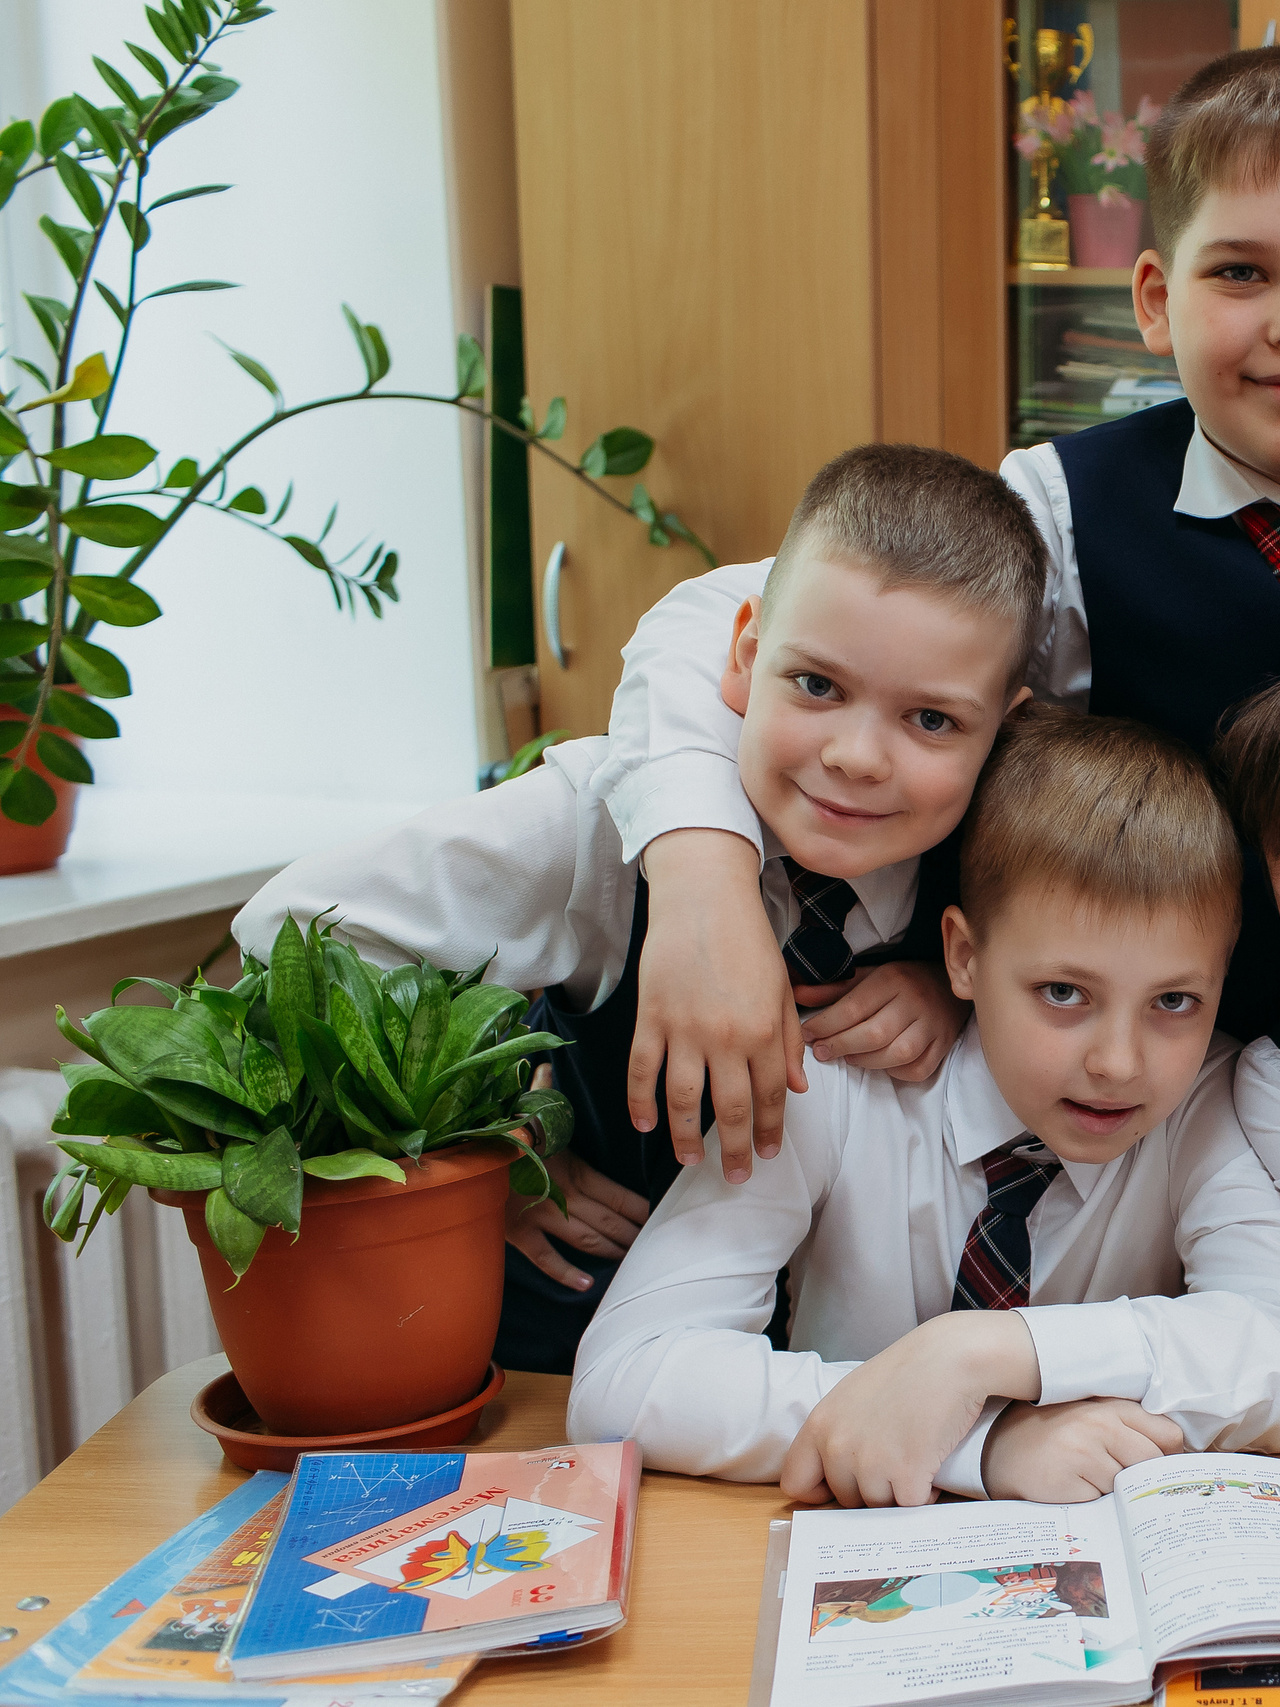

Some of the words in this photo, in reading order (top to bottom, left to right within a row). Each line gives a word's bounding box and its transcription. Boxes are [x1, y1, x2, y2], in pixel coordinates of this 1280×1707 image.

[332, 1486, 509, 1564] Математика
[508, 1523, 550, 1531] Рудницкая
[360, 1528, 392, 1540] Часть
[322, 1542, 358, 1557] вторая
[530, 1585, 556, 1603] 3
